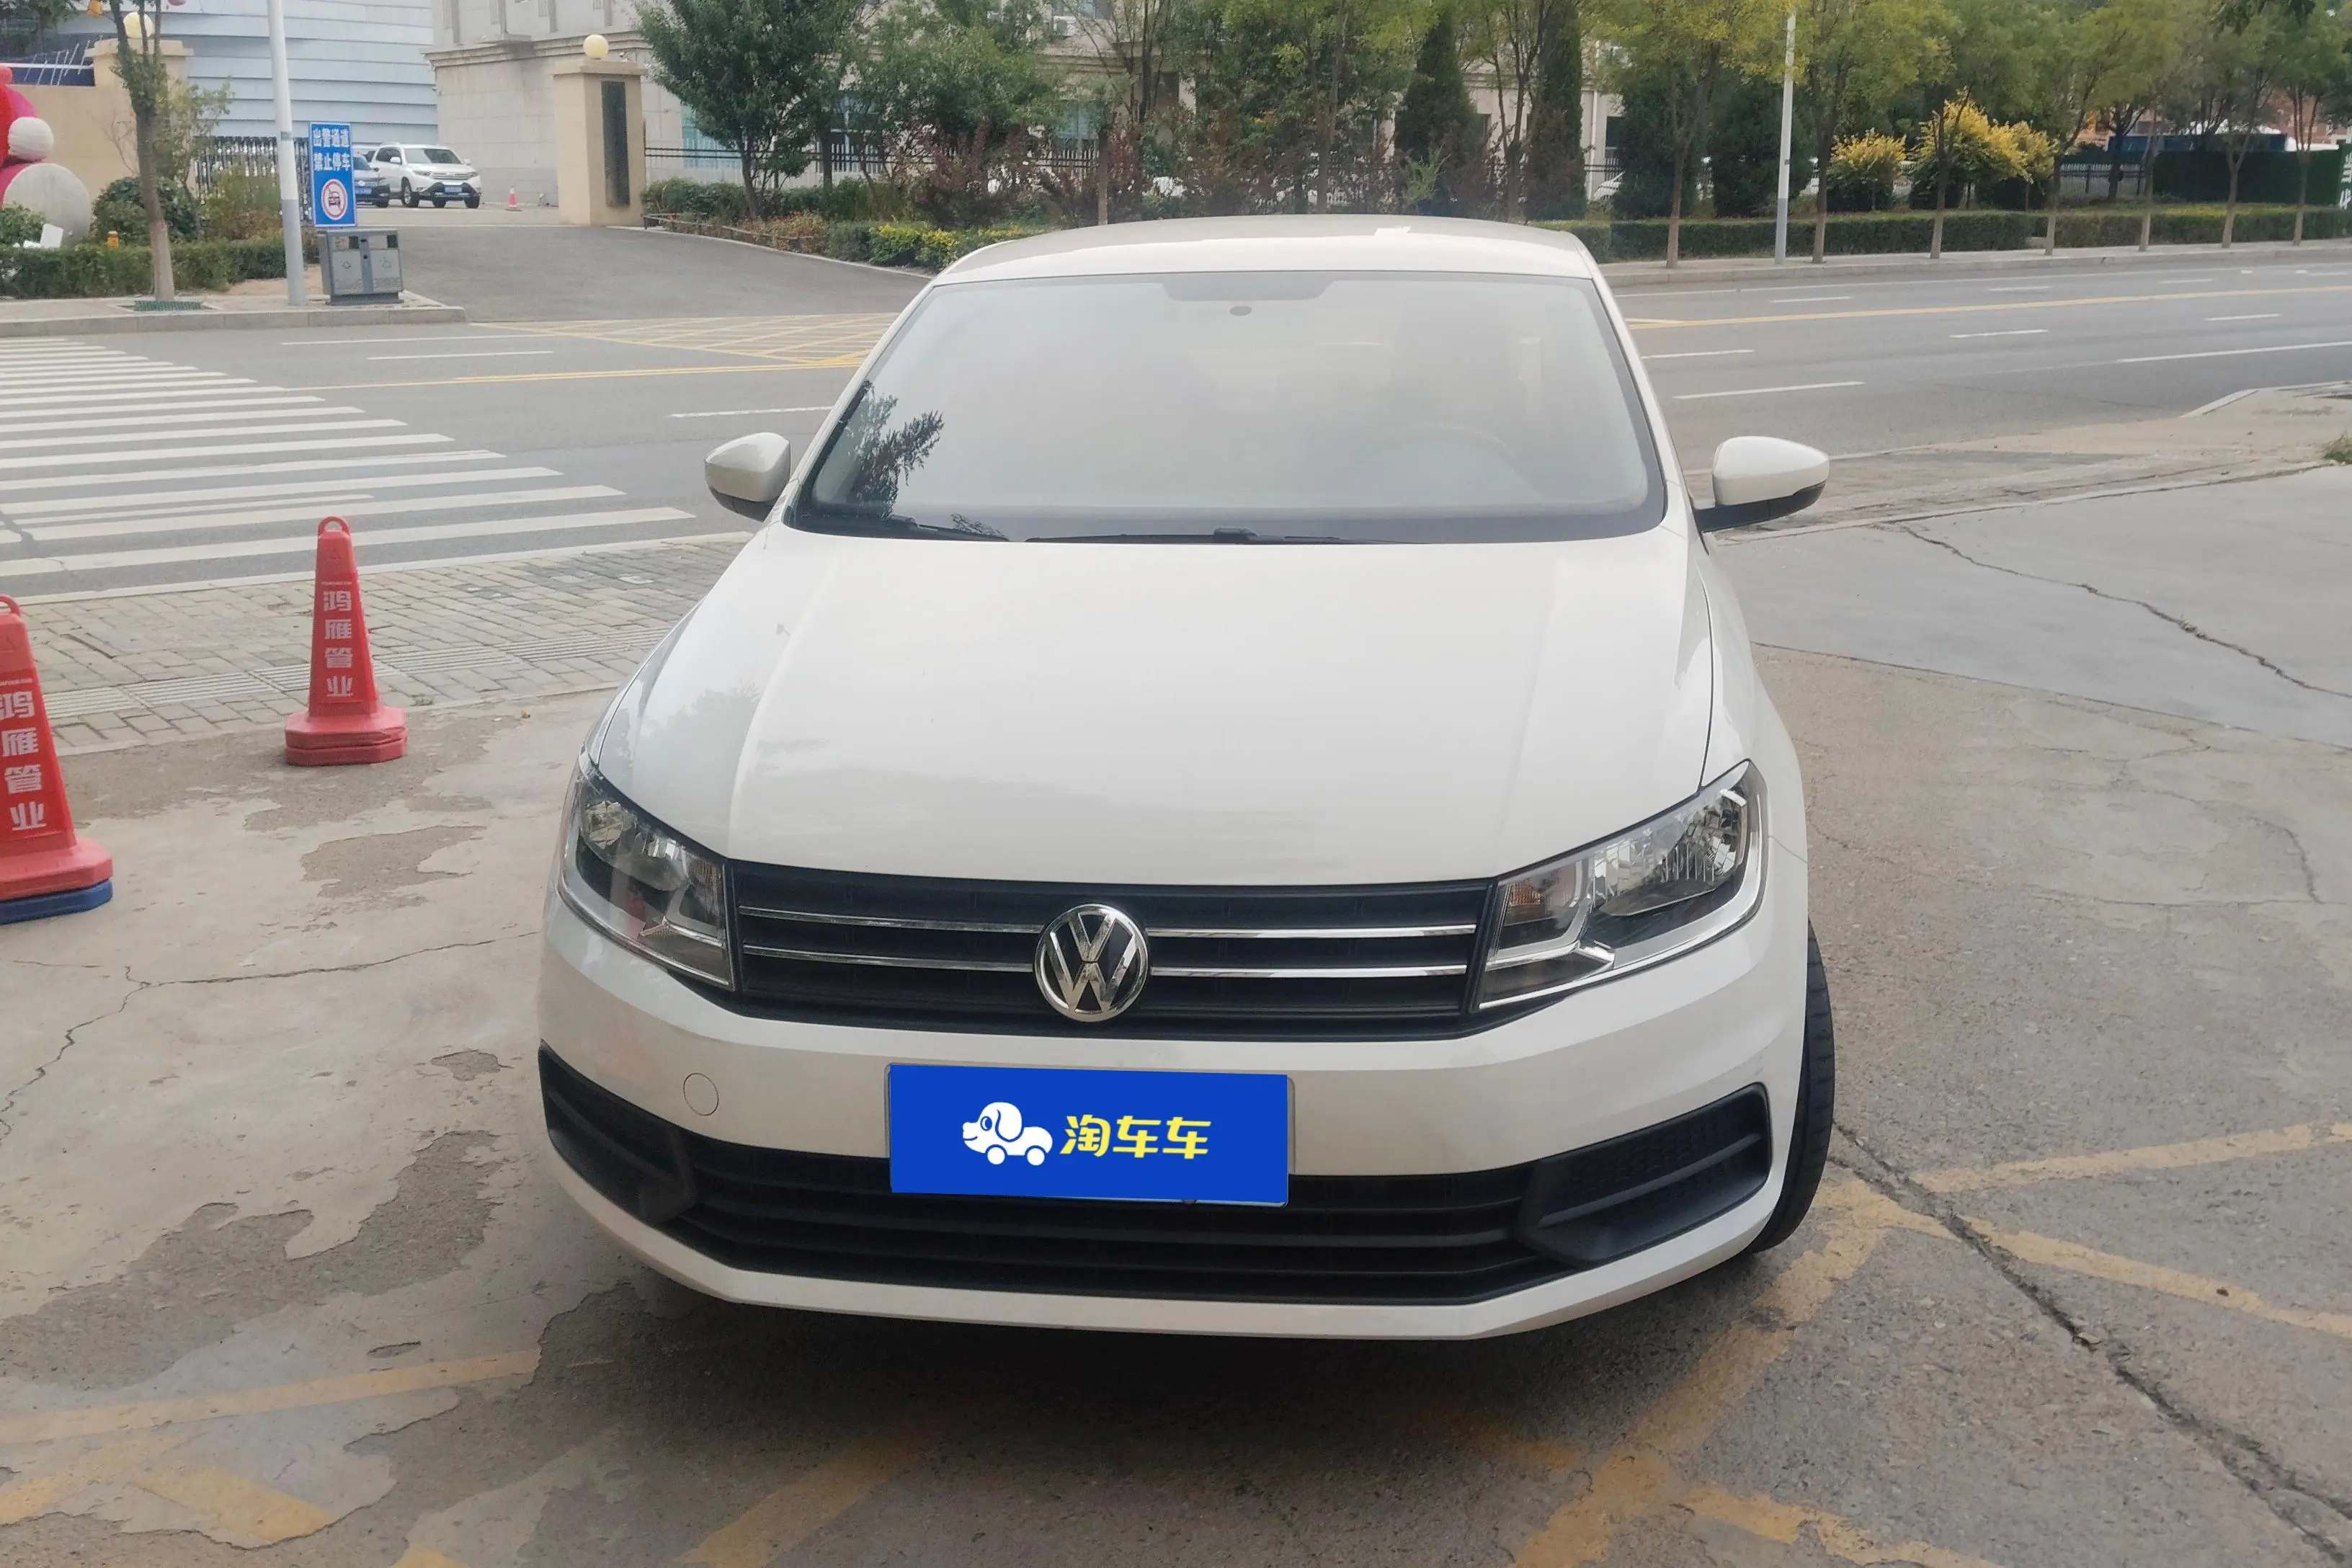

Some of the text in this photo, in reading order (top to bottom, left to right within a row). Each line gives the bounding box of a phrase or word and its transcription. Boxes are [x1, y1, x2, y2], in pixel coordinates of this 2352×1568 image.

[313, 127, 349, 148] 出警通道
[313, 152, 351, 172] 禁止停车
[323, 590, 353, 697] 鸿雁管业
